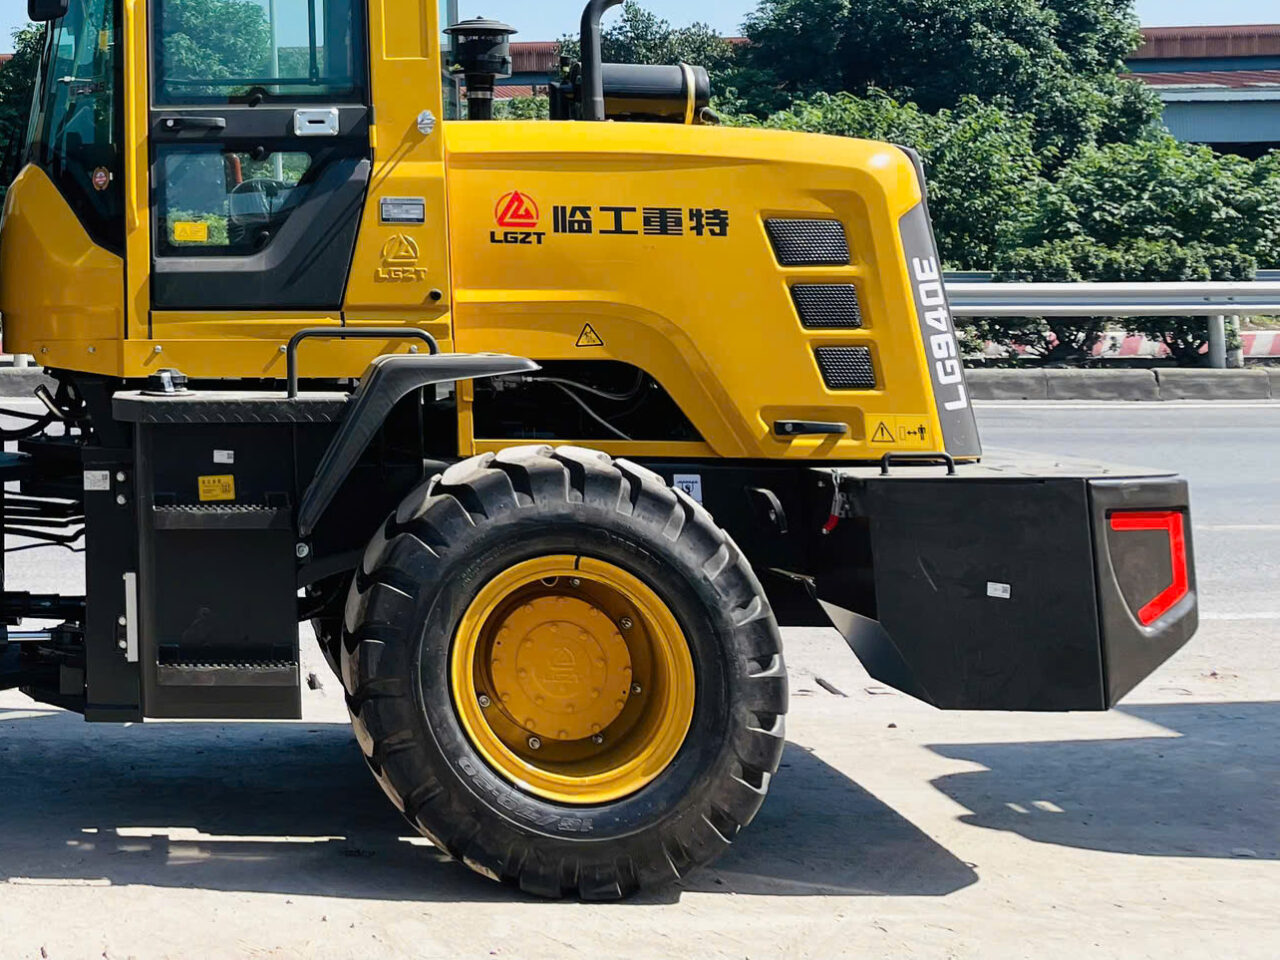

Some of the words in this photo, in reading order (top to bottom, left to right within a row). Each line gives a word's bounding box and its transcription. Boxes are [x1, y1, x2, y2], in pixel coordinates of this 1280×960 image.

[553, 205, 729, 237] 临工重特
[490, 231, 546, 245] LGZT
[376, 266, 428, 282] LGZT
[913, 255, 969, 411] LG940E
